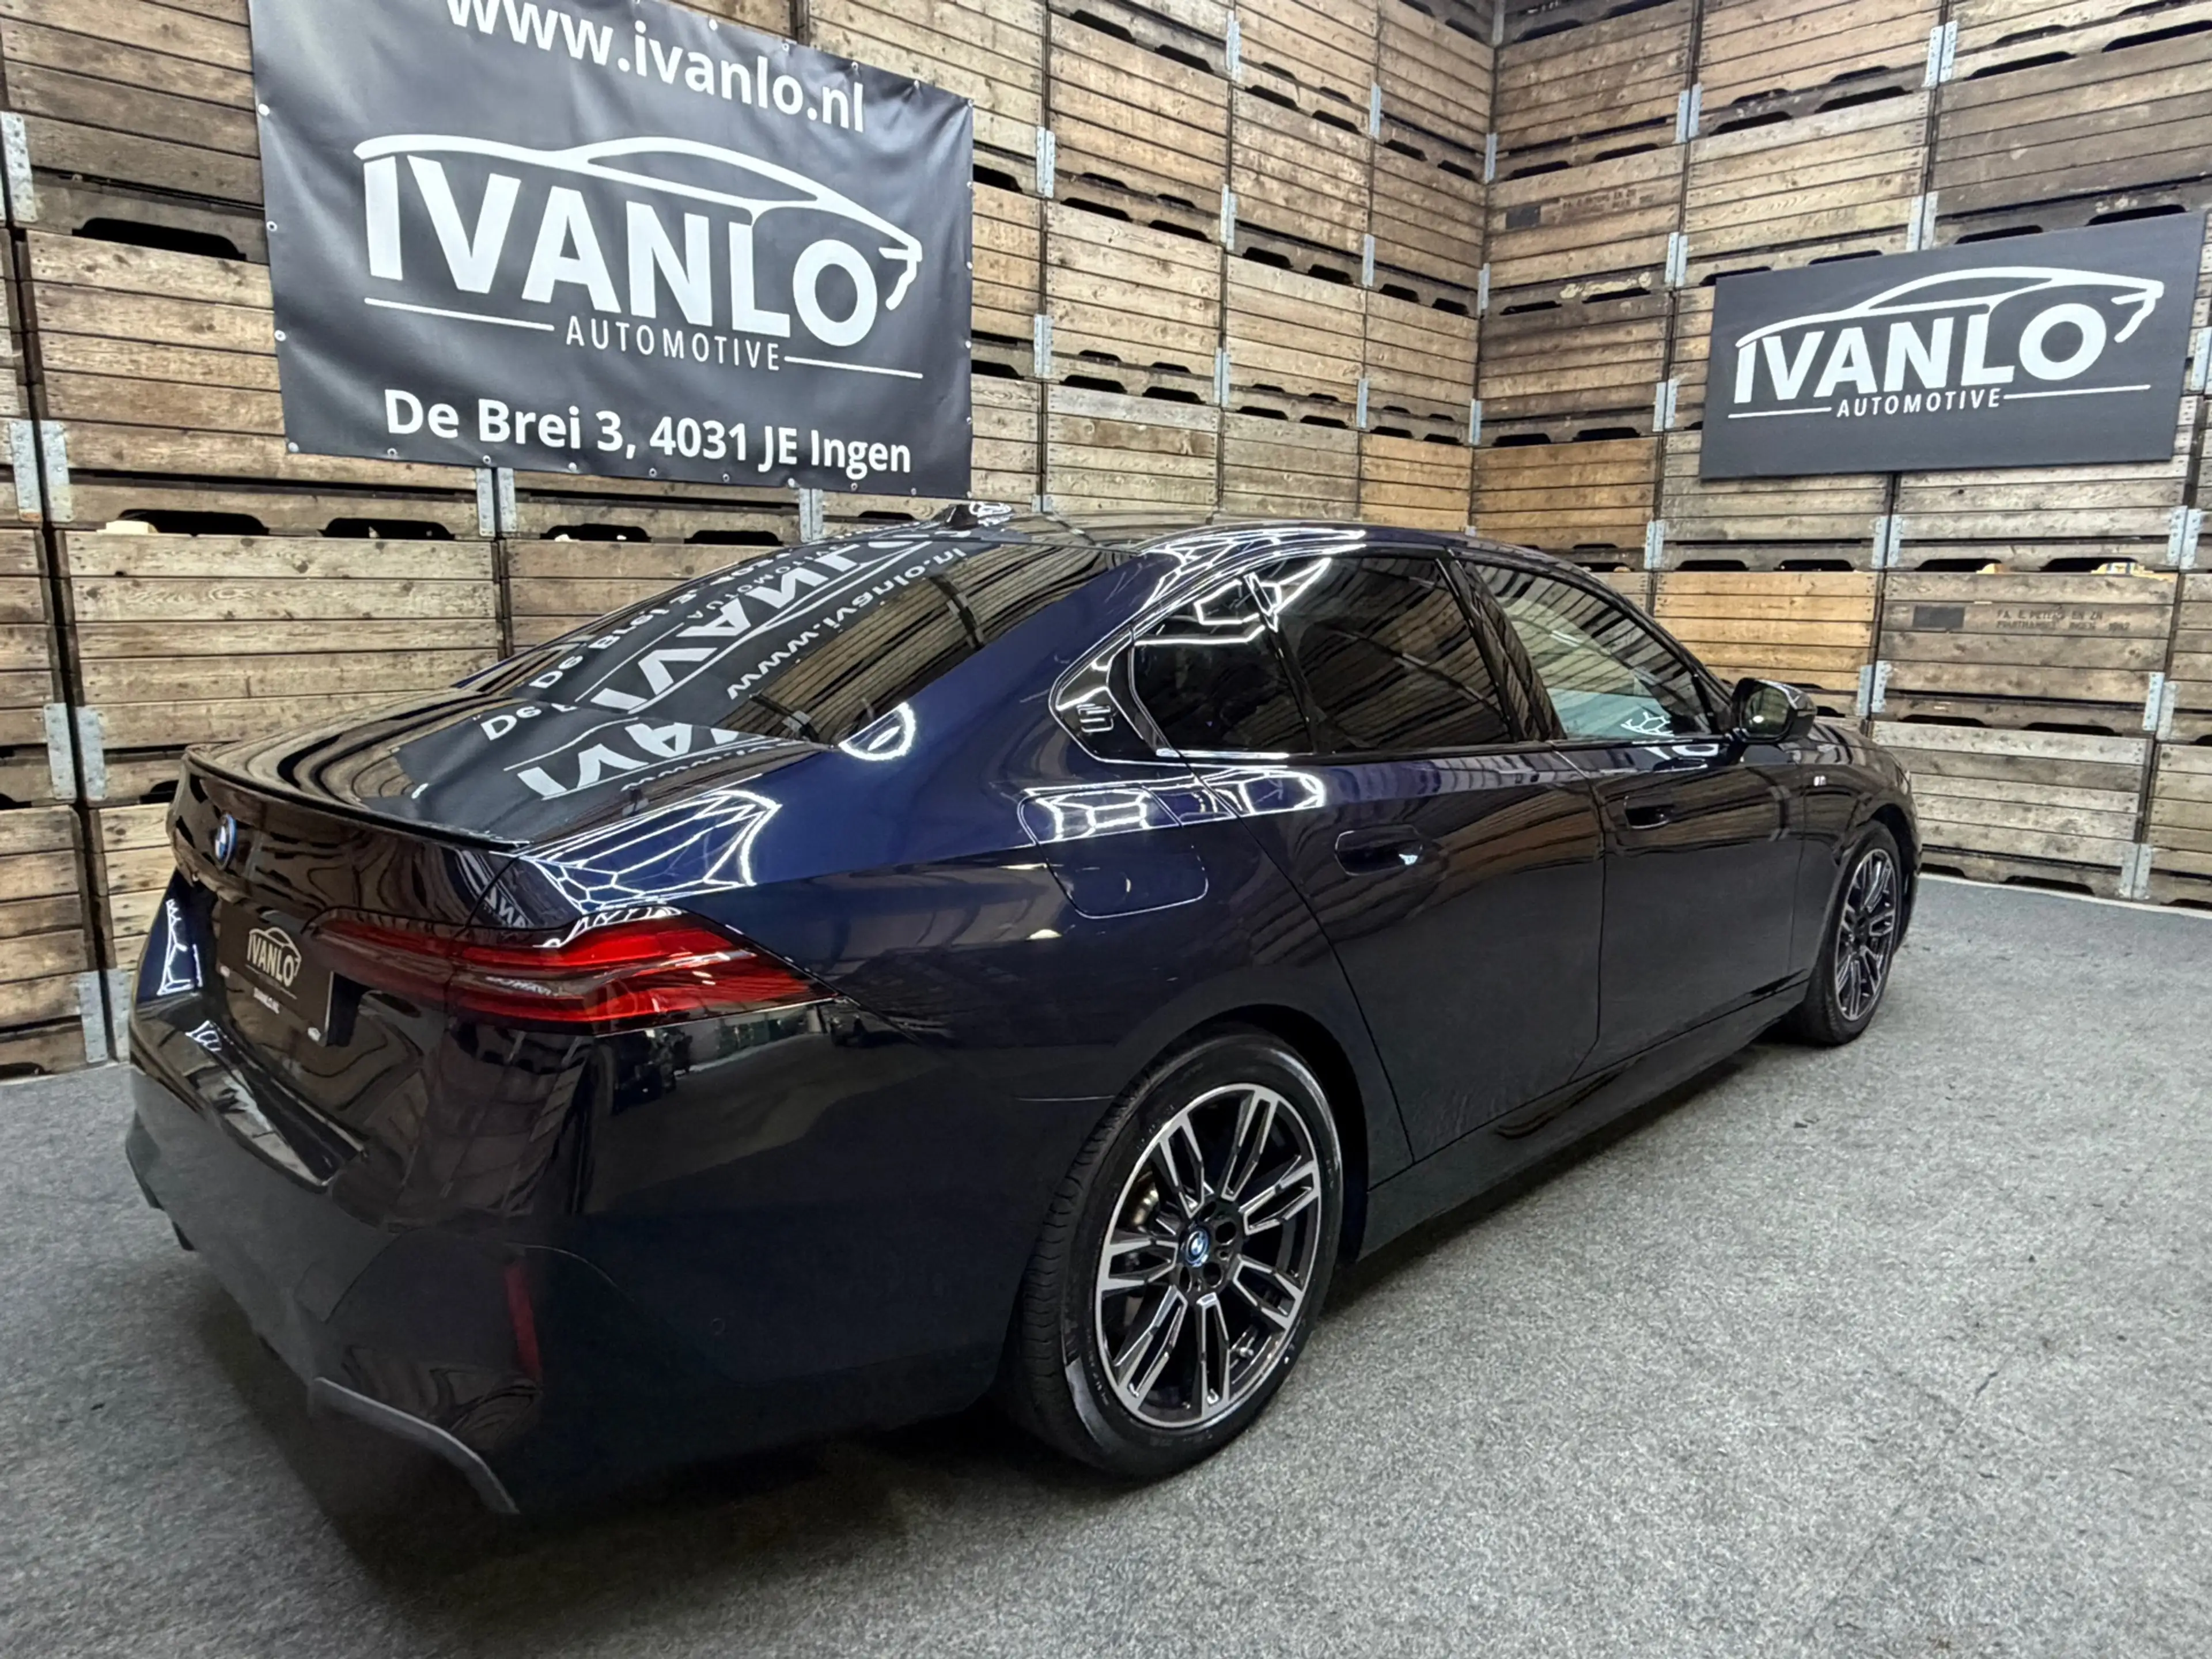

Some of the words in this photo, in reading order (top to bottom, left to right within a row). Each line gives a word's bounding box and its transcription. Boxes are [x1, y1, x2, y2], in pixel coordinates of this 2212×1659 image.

[446, 0, 864, 134] www.ivanlo.nl
[363, 154, 878, 347] IVANLO
[566, 315, 779, 370] AUTOMOTIVE
[1734, 303, 2107, 404] IVANLO
[385, 389, 459, 438] De
[478, 399, 580, 449] Brei
[596, 411, 636, 459] 3,
[649, 416, 746, 460] 4031
[758, 426, 797, 472] JE
[811, 430, 910, 480] Ingen
[1836, 388, 2001, 418] AUTOMOTIVE
[247, 934, 295, 987] IVANLO
